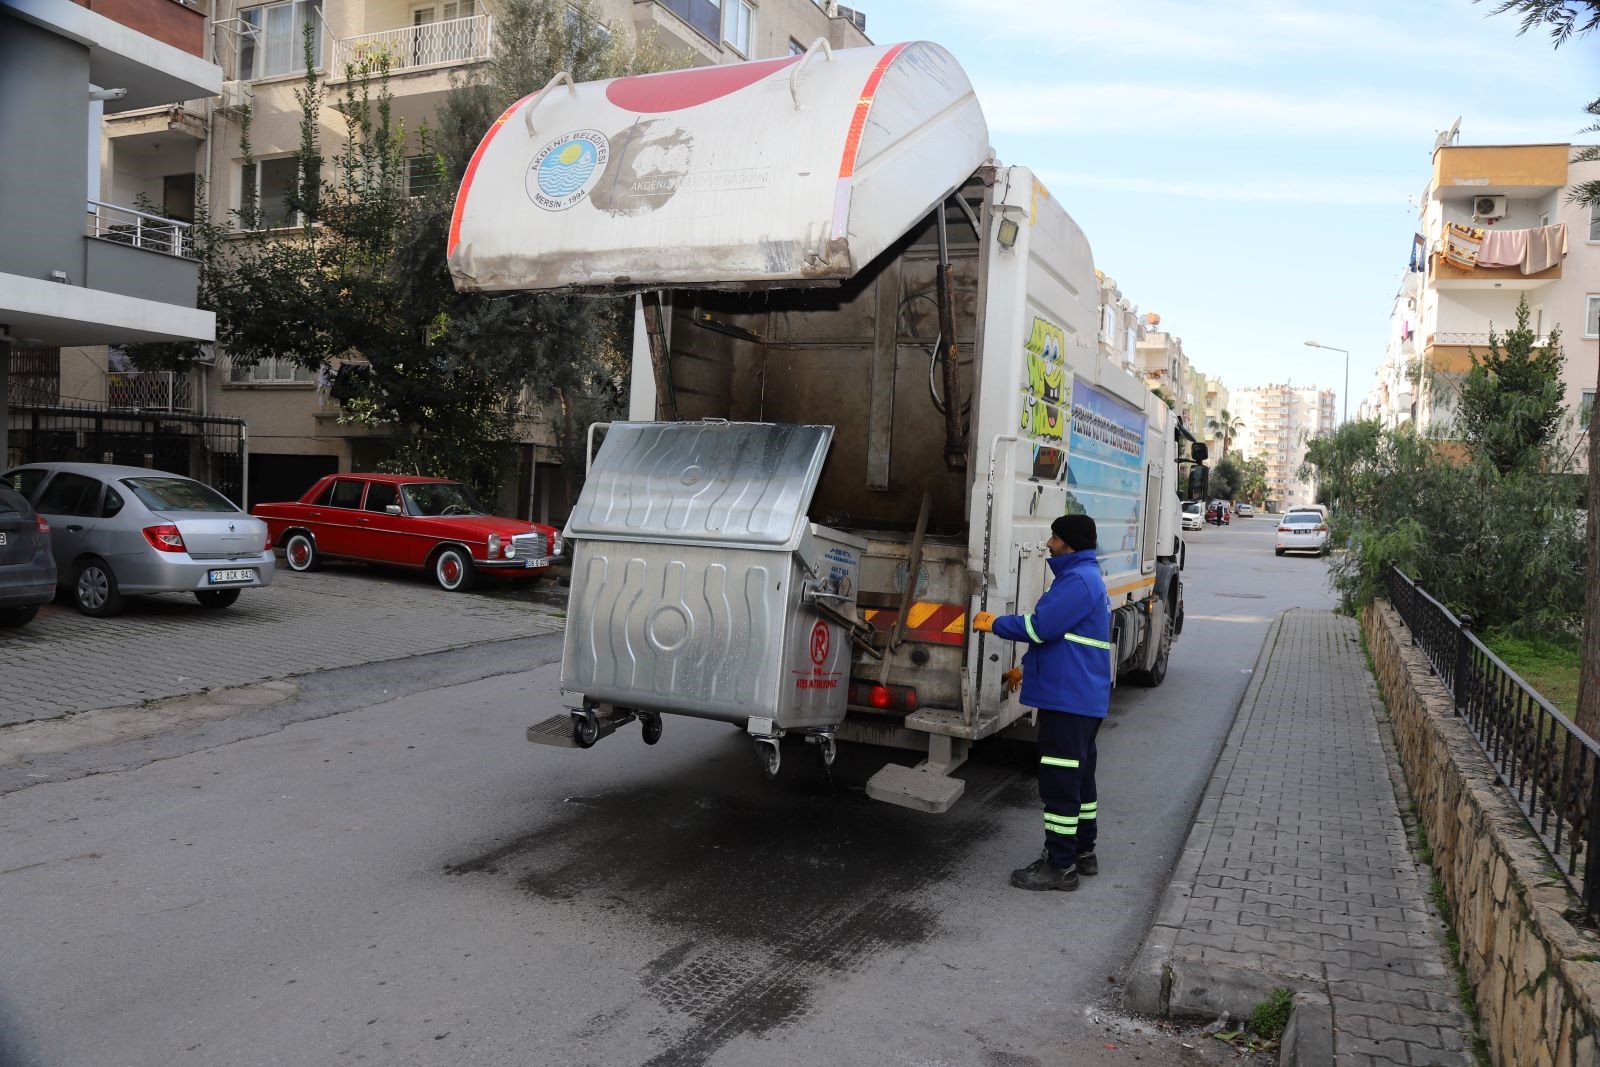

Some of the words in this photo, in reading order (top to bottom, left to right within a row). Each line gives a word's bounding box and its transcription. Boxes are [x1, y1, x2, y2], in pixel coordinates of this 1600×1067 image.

[531, 135, 570, 171] AKDENİZ
[573, 132, 606, 165] BELEDİYESİ
[534, 193, 562, 208] MERSİN
[567, 189, 585, 204] 1994
[214, 571, 223, 581] 23
[226, 571, 238, 580] ACK
